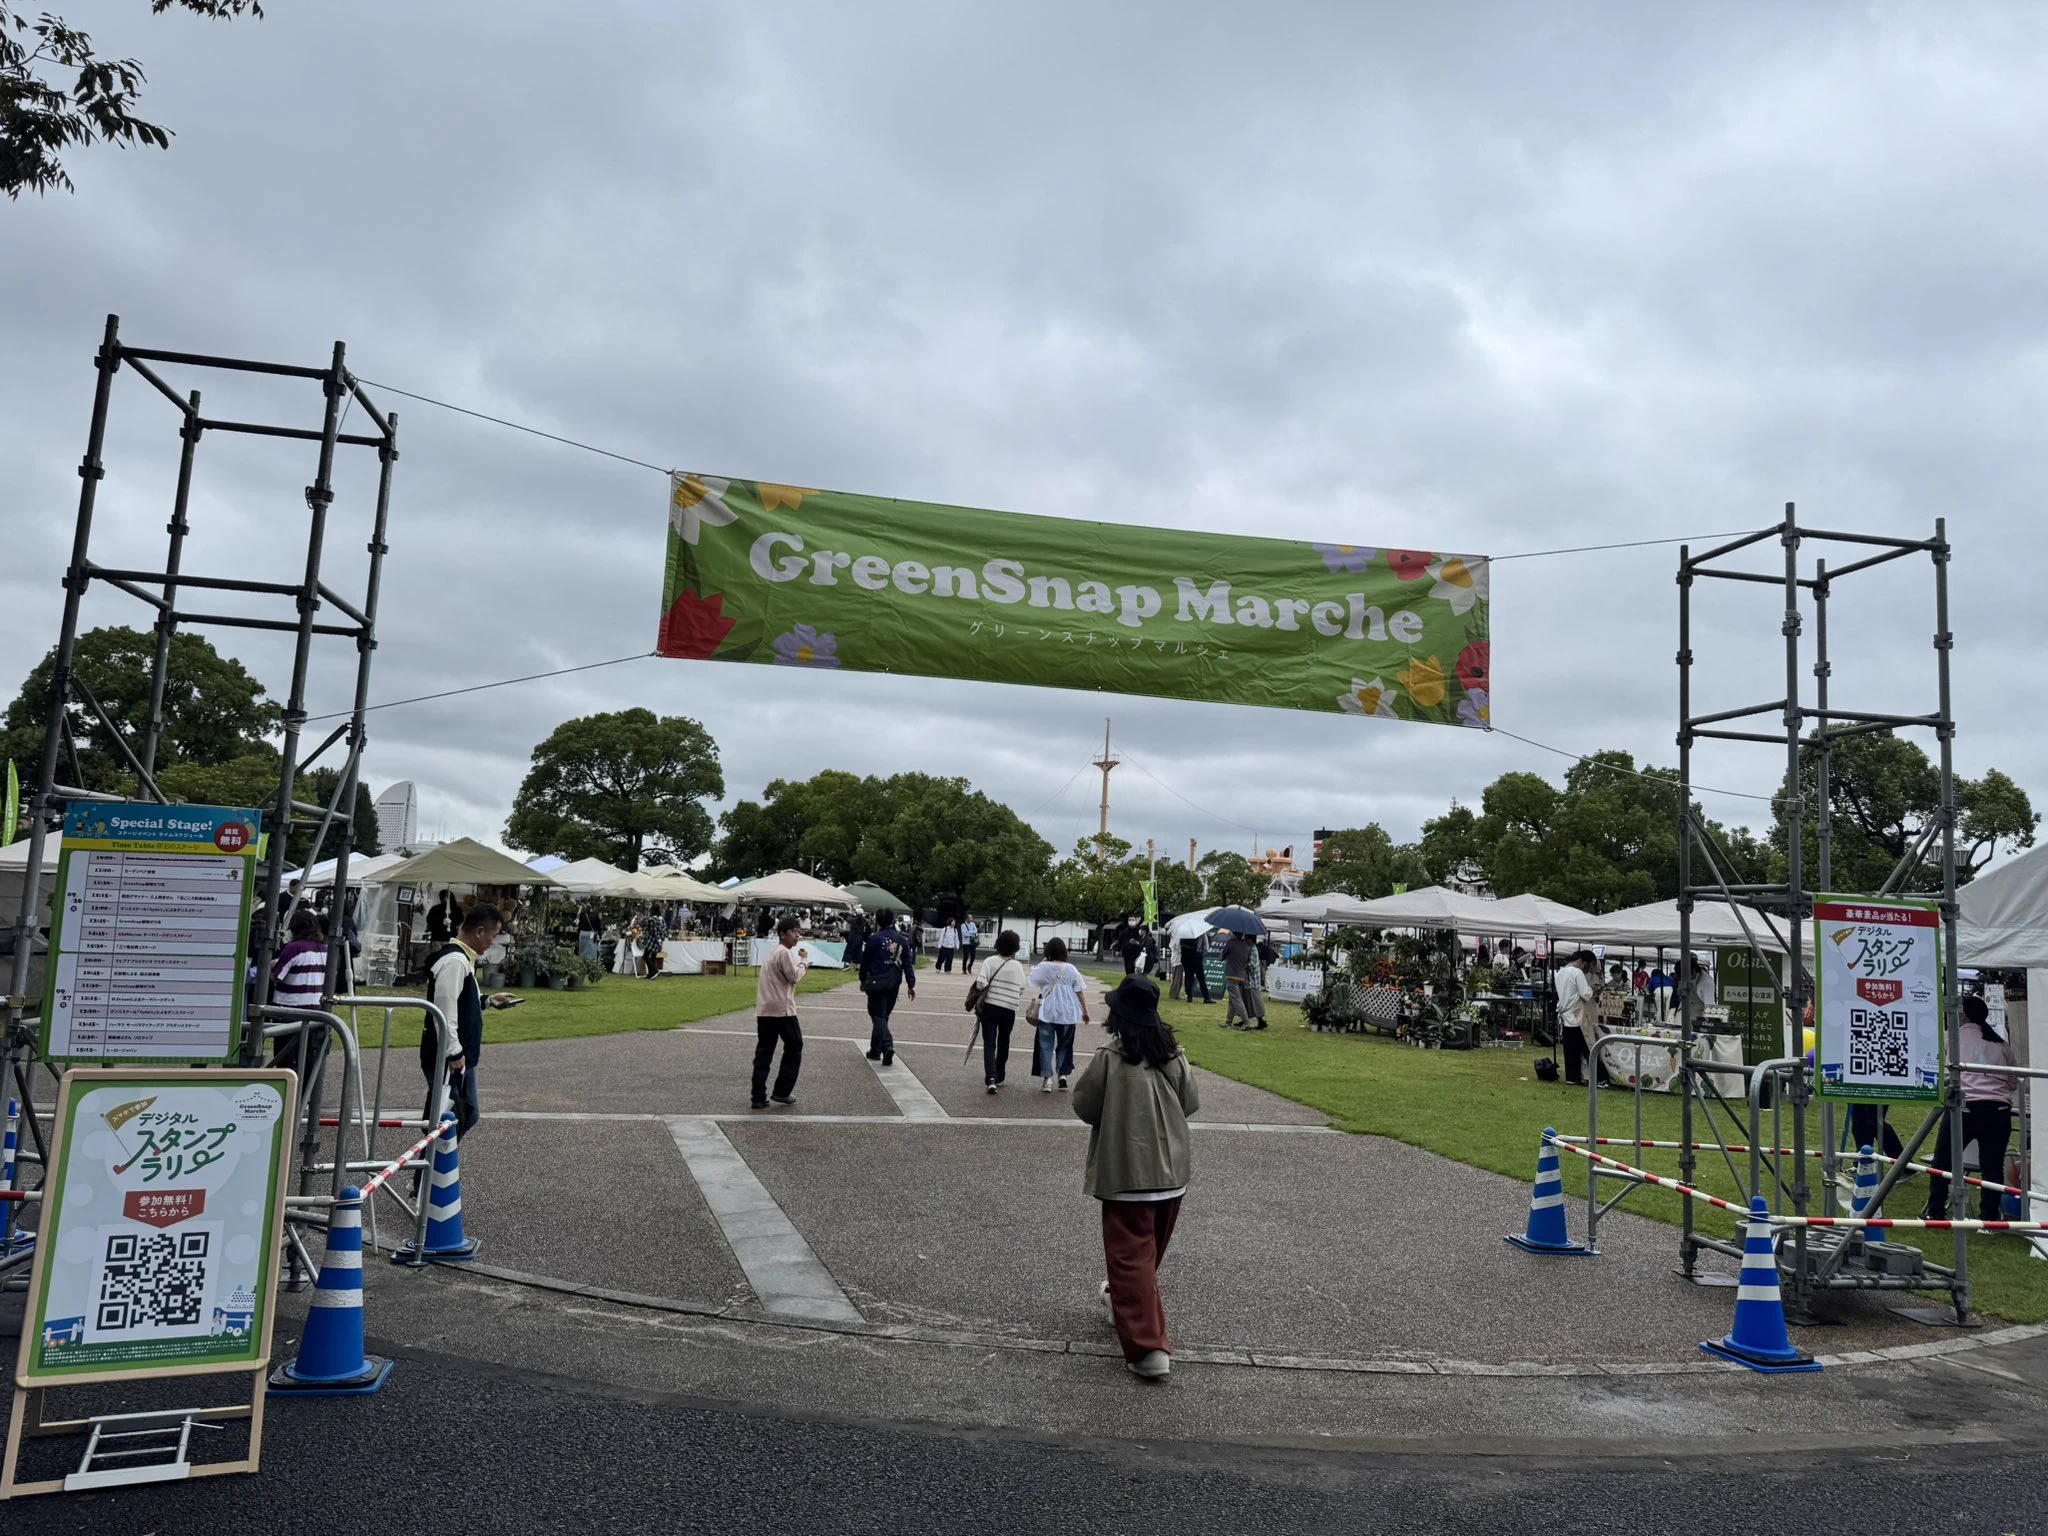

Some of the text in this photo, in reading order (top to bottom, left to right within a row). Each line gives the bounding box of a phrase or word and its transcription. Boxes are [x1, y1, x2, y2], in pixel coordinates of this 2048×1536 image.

[749, 531, 1424, 643] GreenSnap Marche
[969, 621, 1229, 660] グリーンスナップマルシェ
[110, 816, 213, 833] Special Stage!
[111, 841, 131, 849] Time
[219, 835, 242, 846] 無料
[1845, 908, 1912, 922] 豪華景品が当たる!
[1857, 925, 1892, 936] デジタル
[1853, 937, 1915, 961] スタンプ
[1864, 982, 1896, 992] 参加無料!
[1864, 991, 1895, 999] こちらから
[138, 1112, 199, 1127] デジタル
[126, 1122, 237, 1166] スタンプ
[138, 1194, 193, 1207] 参加無料!
[137, 1206, 190, 1218] こちらから
